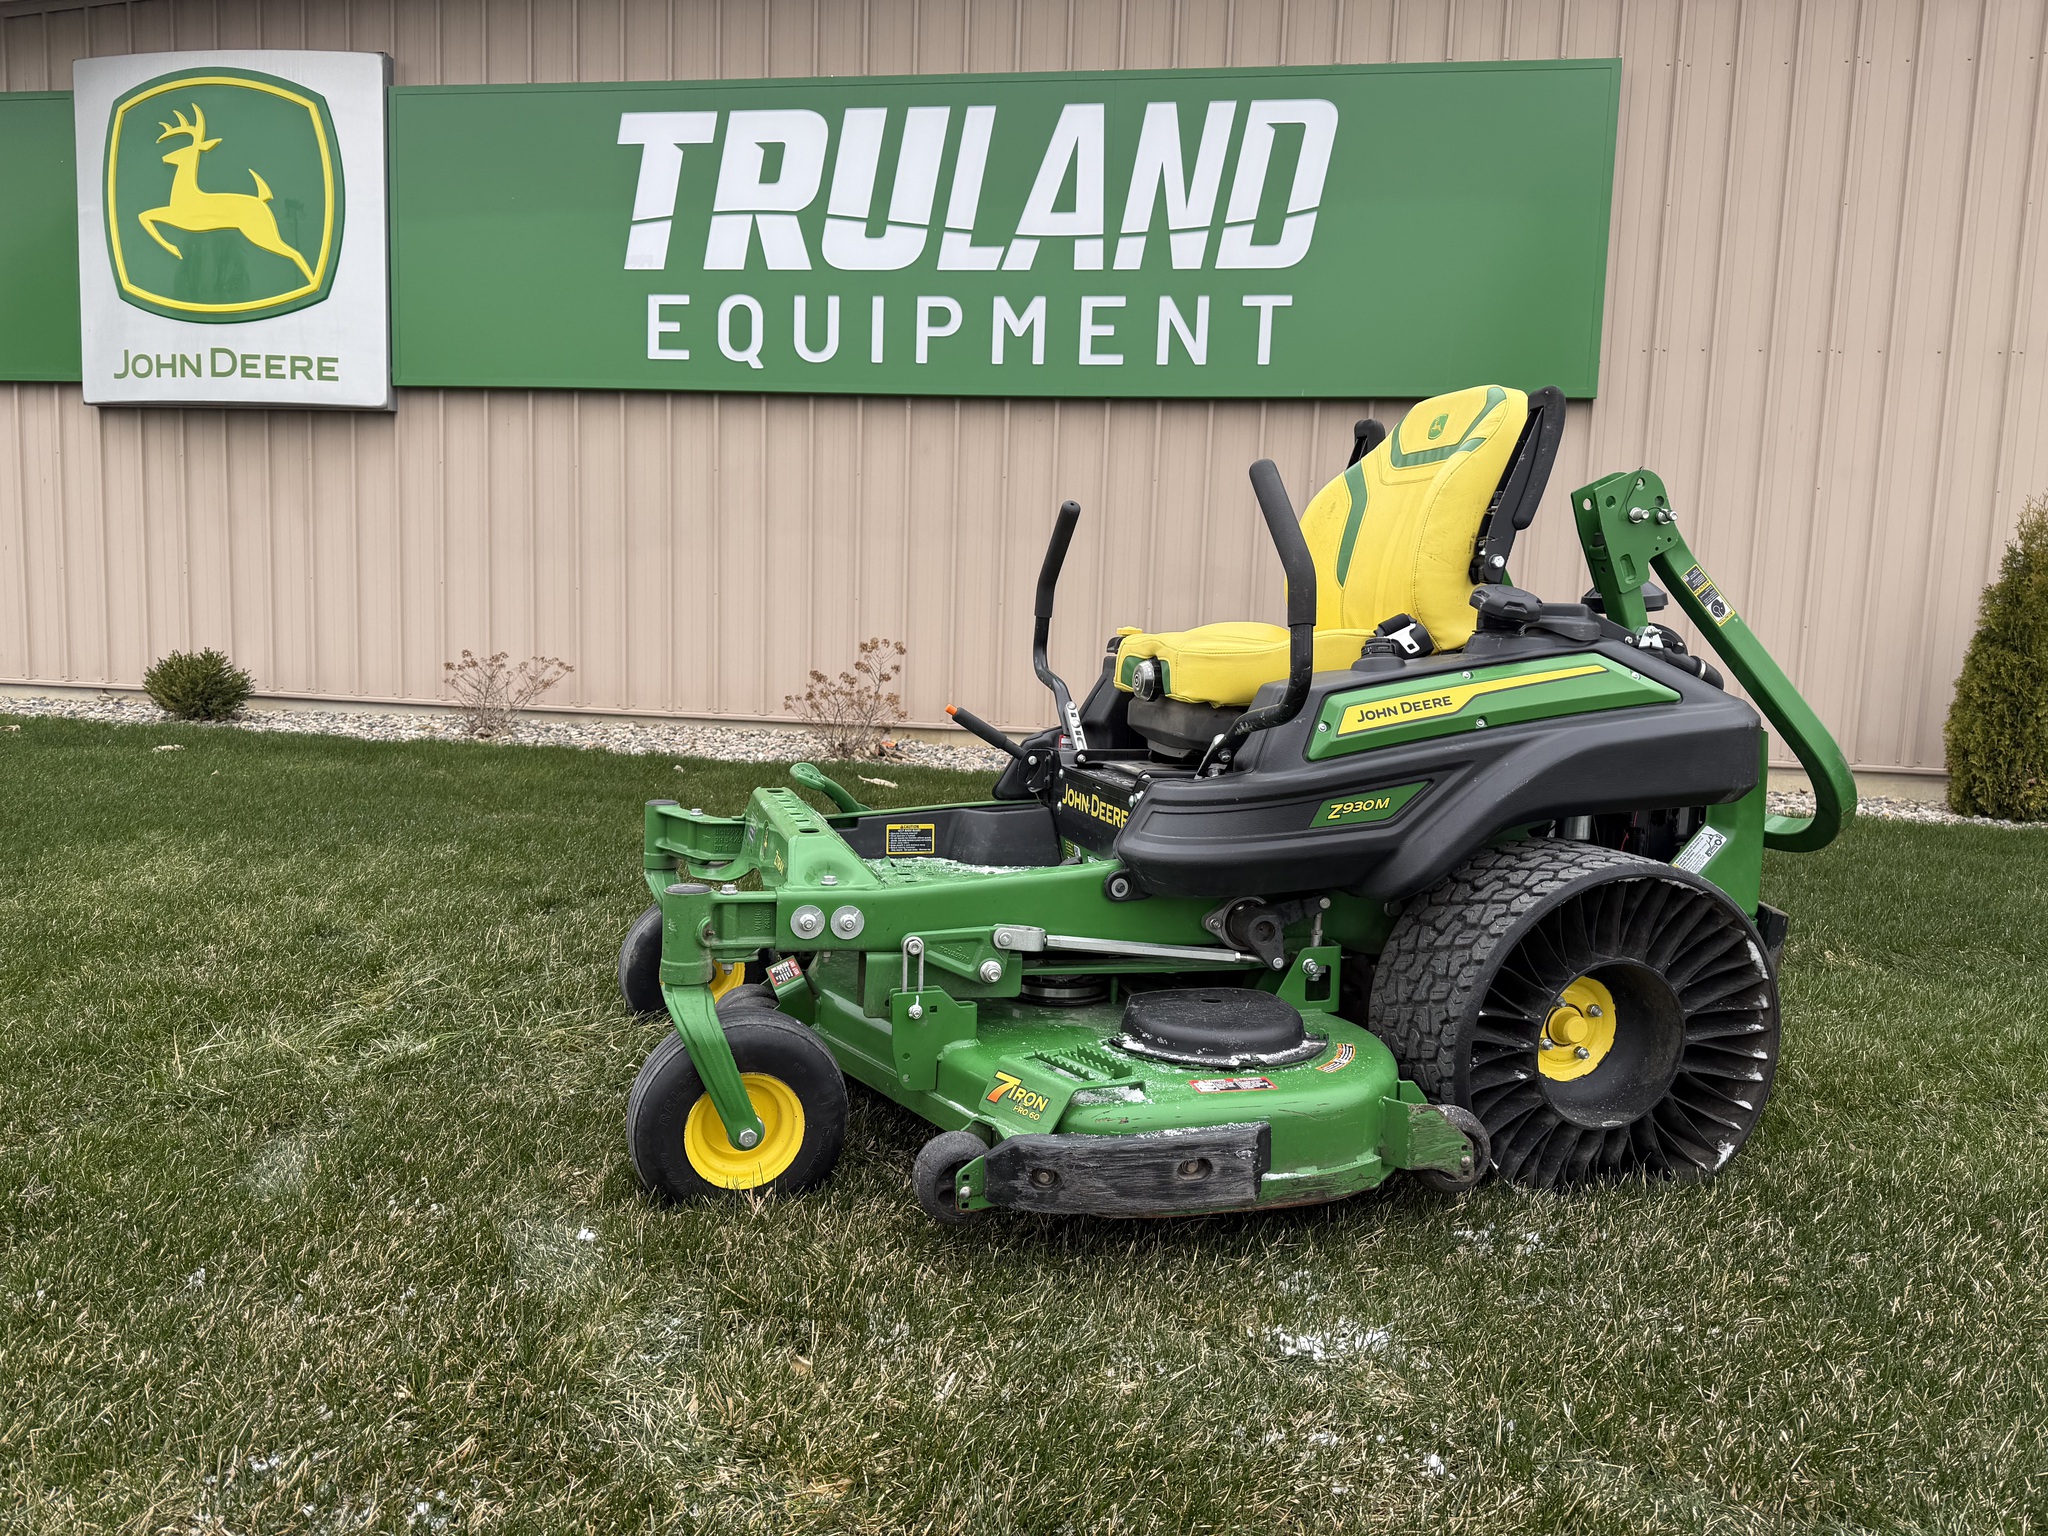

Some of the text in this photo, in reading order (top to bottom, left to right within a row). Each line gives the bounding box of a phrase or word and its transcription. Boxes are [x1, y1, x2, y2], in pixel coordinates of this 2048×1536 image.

[616, 98, 1339, 270] TRULAND
[647, 294, 1293, 369] EQUIPMENT
[113, 347, 339, 382] JOHN DEERE
[1357, 695, 1453, 723] JOHN DEERE
[1062, 783, 1089, 814] JOHN
[1326, 797, 1391, 820] Z930M
[1012, 1105, 1041, 1121] PRO 60
